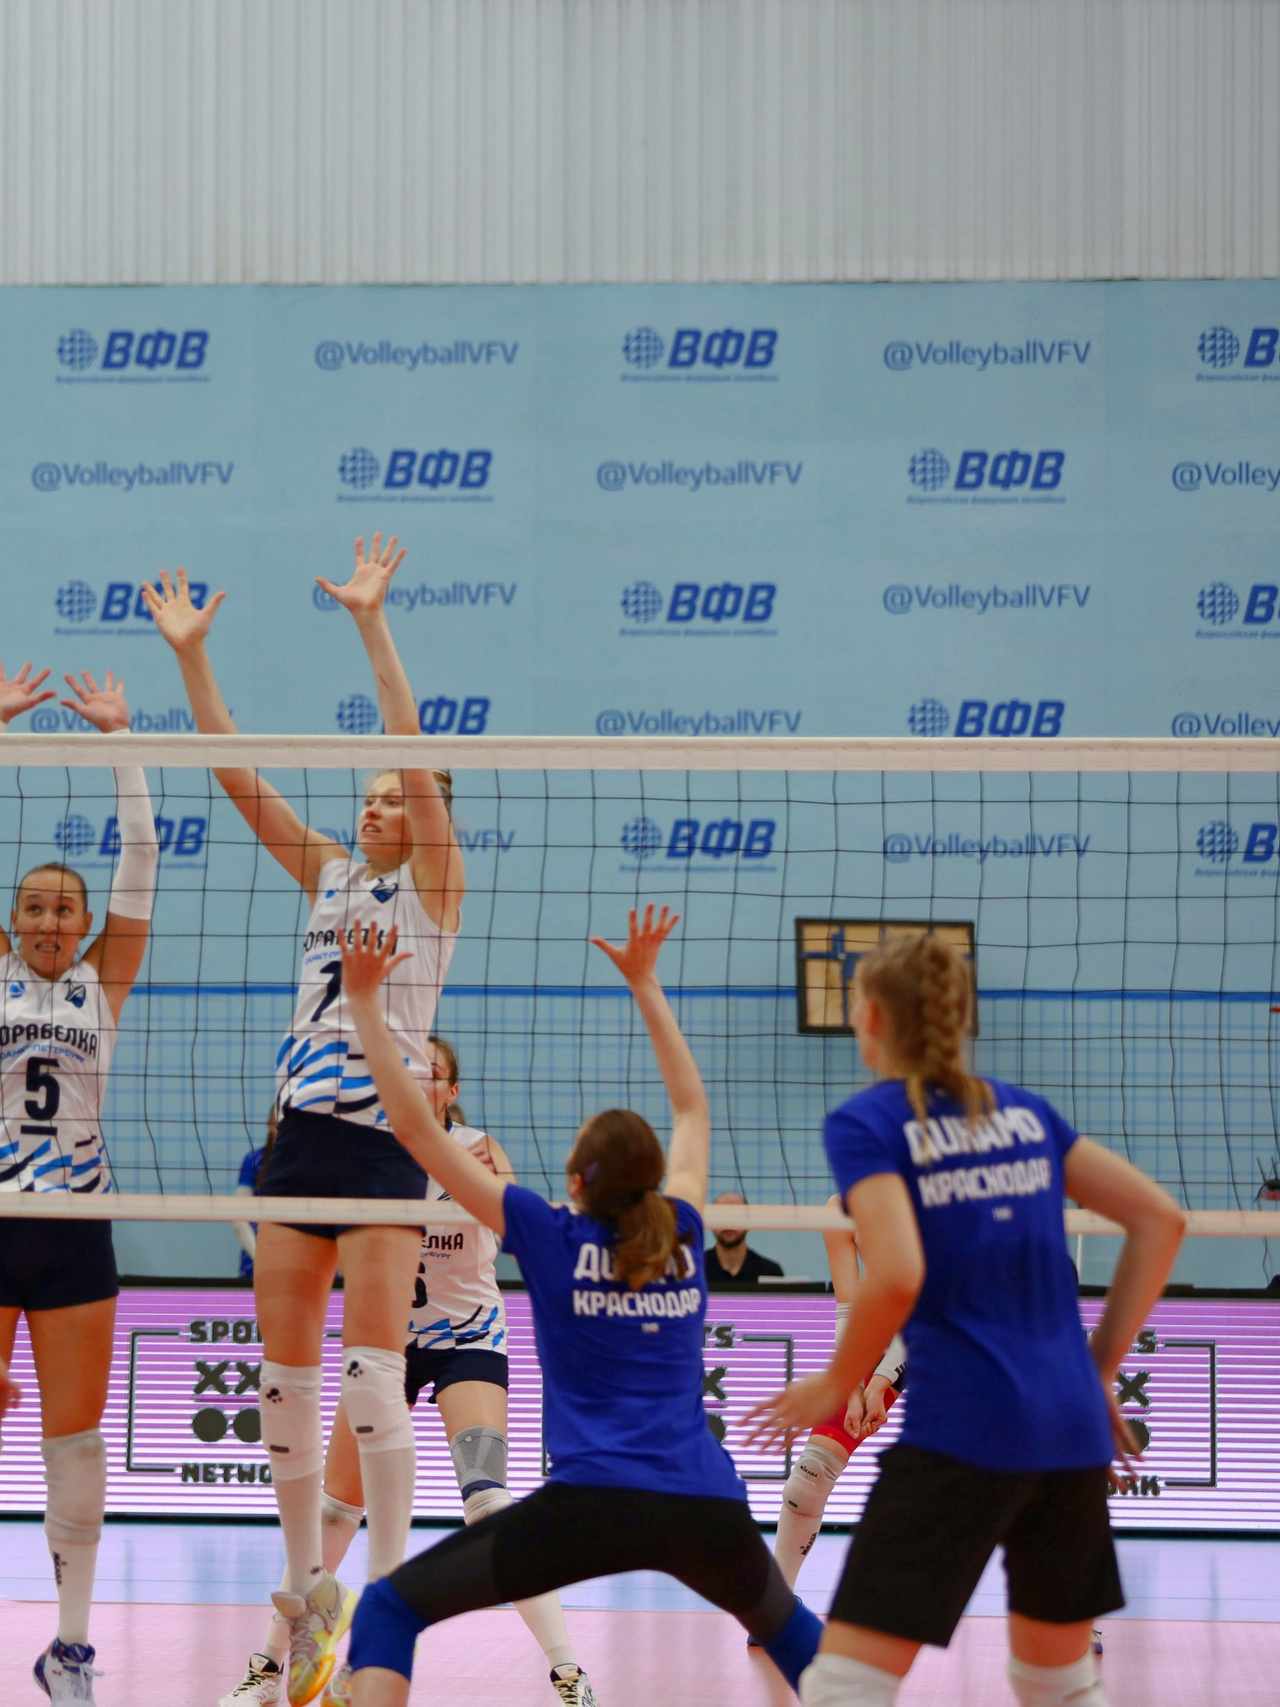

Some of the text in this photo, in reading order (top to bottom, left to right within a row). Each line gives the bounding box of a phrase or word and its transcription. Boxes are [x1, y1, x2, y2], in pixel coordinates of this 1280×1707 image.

[102, 329, 209, 369] ВФВ
[315, 340, 518, 371] @VolleyballVFV
[669, 328, 778, 368] ВФВ
[883, 339, 1090, 371] @VolleyballVFV
[32, 461, 234, 492] @VolleyballVFV
[384, 449, 492, 489] ВФВ
[597, 461, 802, 492] @VolleyballVFV
[955, 450, 1065, 490] ВФВ
[668, 583, 777, 623] ВФВ
[883, 584, 1090, 614] @VolleyballVFV
[596, 709, 802, 737] @VolleyballVFV
[955, 698, 1066, 738] ВФВ
[668, 817, 777, 859] ВФВ
[882, 832, 1091, 864] @VolleyballVFV
[24, 1056, 60, 1122] 5
[917, 1157, 1051, 1208] КРАСНОДАР
[573, 1287, 702, 1317] КРАСНОДАР
